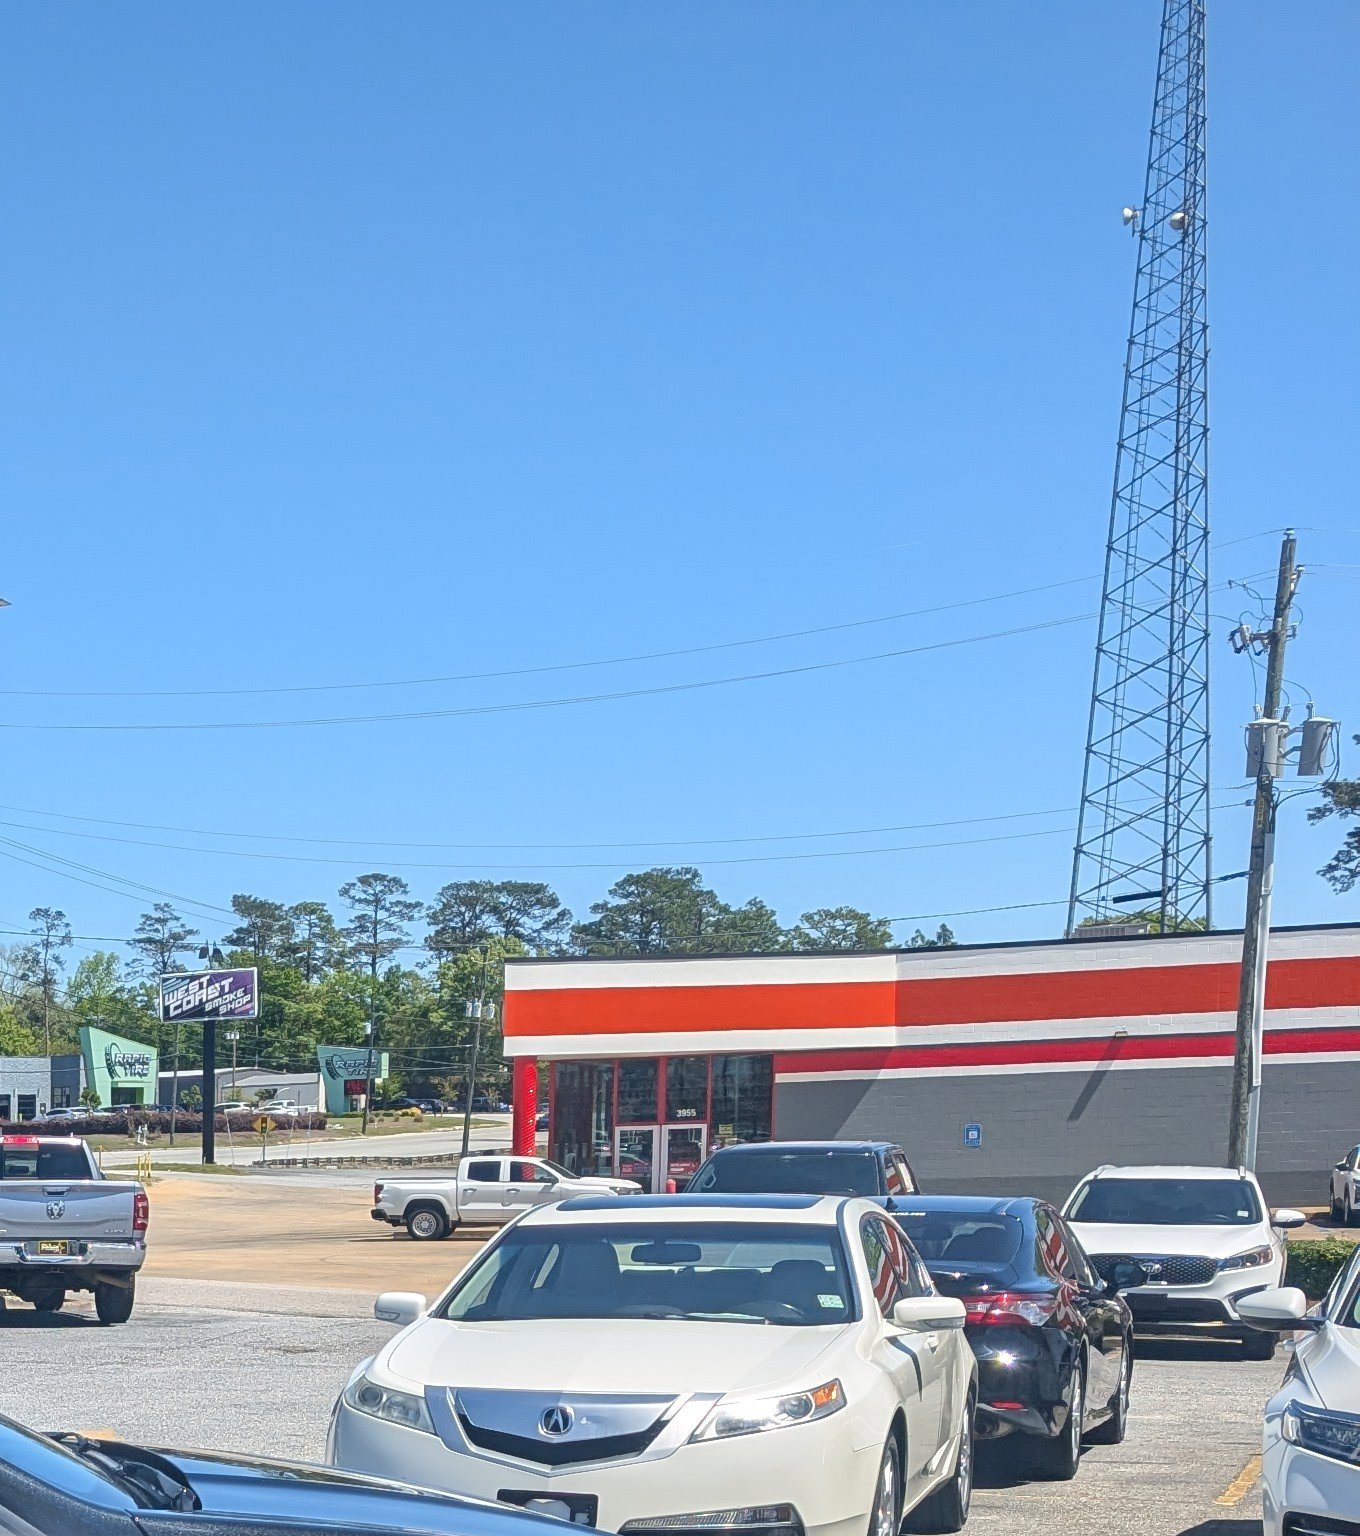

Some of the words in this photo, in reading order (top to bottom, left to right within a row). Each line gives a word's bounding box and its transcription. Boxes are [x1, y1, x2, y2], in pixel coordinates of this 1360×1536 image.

[165, 975, 211, 1006] WEST
[169, 977, 233, 1018] COAST
[204, 987, 245, 1012] SMOKE
[219, 994, 251, 1015] SHOP
[115, 1053, 151, 1064] RAPID
[125, 1065, 150, 1077] TIRE
[676, 1109, 697, 1117] 3955
